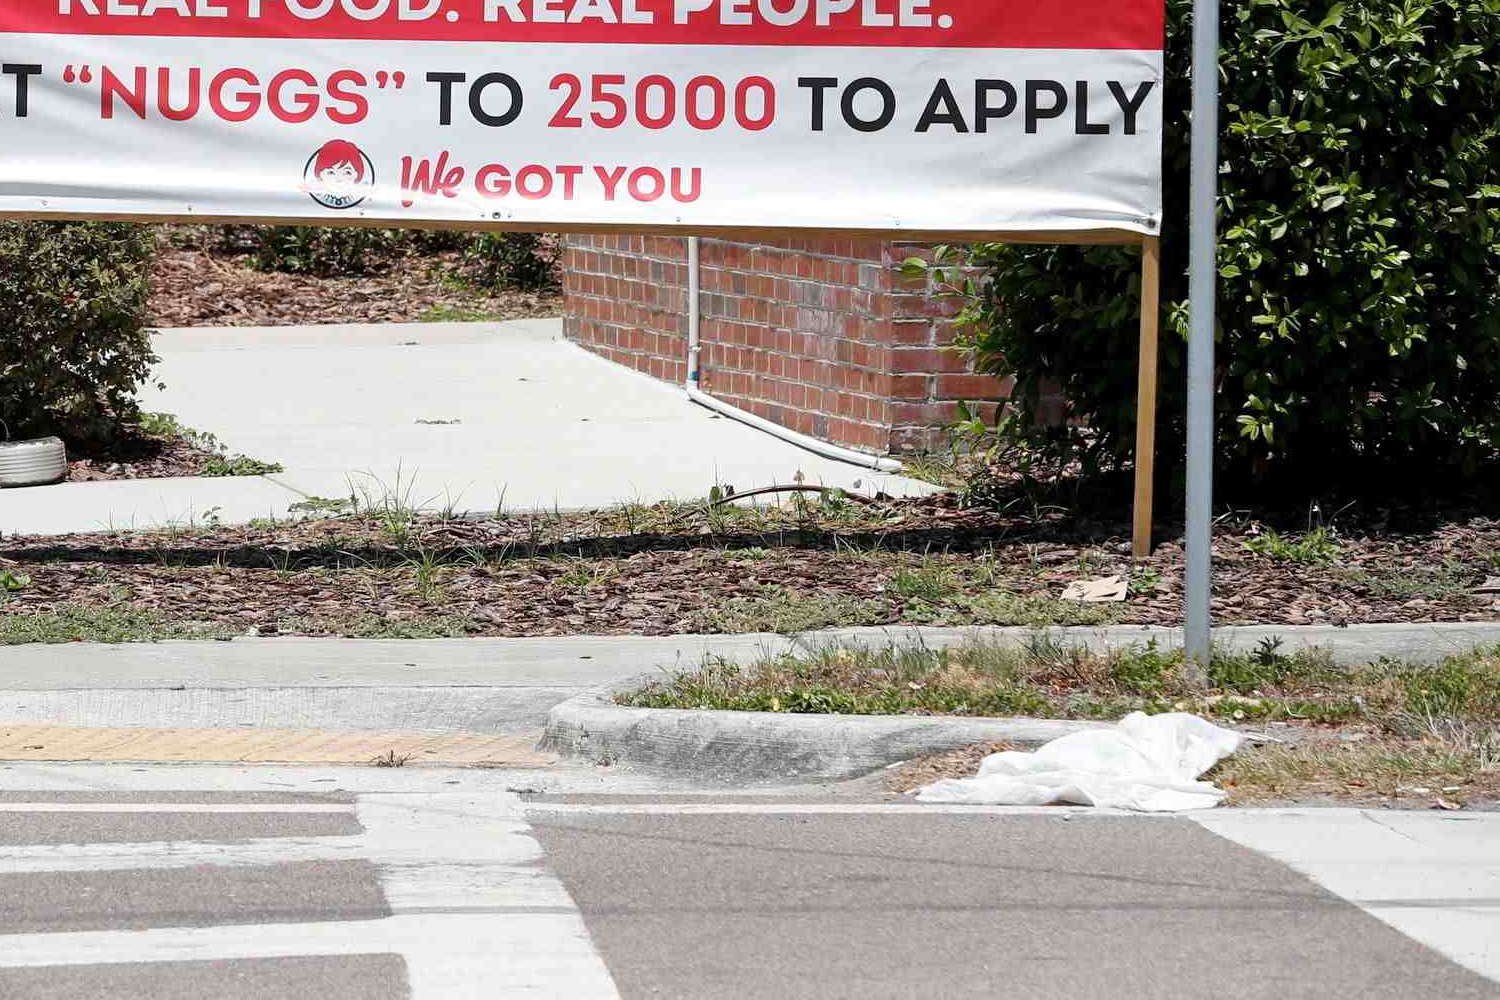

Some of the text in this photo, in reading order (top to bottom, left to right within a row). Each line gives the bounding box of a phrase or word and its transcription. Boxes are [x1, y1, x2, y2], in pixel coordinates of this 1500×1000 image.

[62, 64, 405, 125] “NUGGS”
[426, 71, 523, 127] TO
[547, 73, 776, 131] 25000
[798, 76, 897, 132] TO
[914, 79, 1154, 135] APPLY
[400, 150, 701, 208] We GOT YOU
